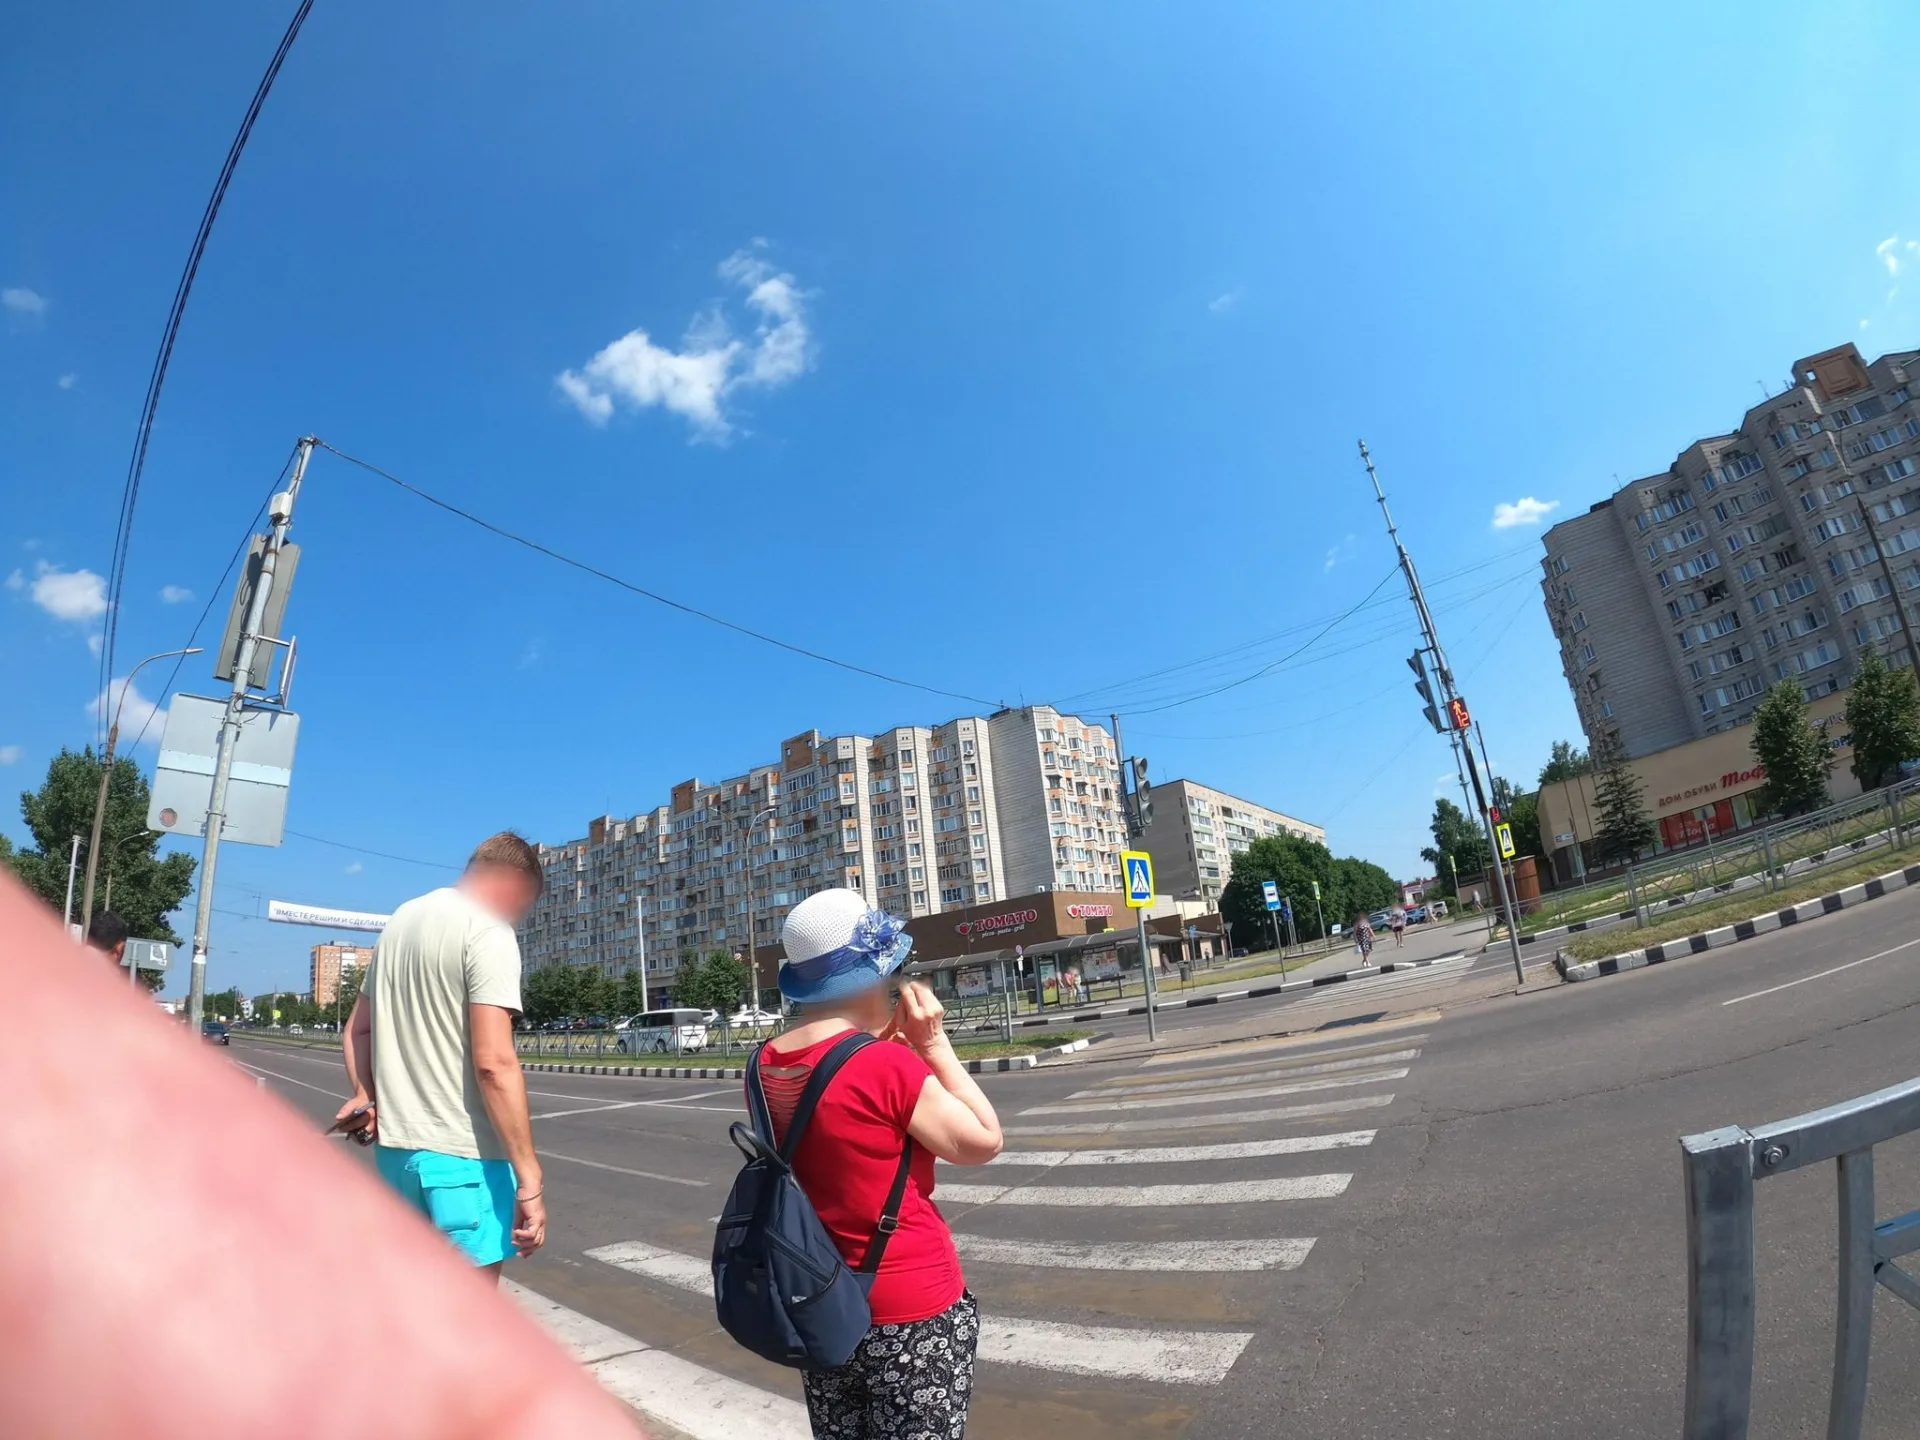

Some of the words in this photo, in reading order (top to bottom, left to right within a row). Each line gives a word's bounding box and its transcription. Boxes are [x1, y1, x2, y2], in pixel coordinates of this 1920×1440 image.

[1659, 793, 1682, 808] ДОМ
[1684, 782, 1717, 799] ОБУВИ
[1079, 904, 1114, 917] TOMATO
[309, 913, 341, 924] РЕШИМ
[348, 918, 387, 928] СДЕЛАЕМ
[976, 909, 1037, 932] TOMATO
